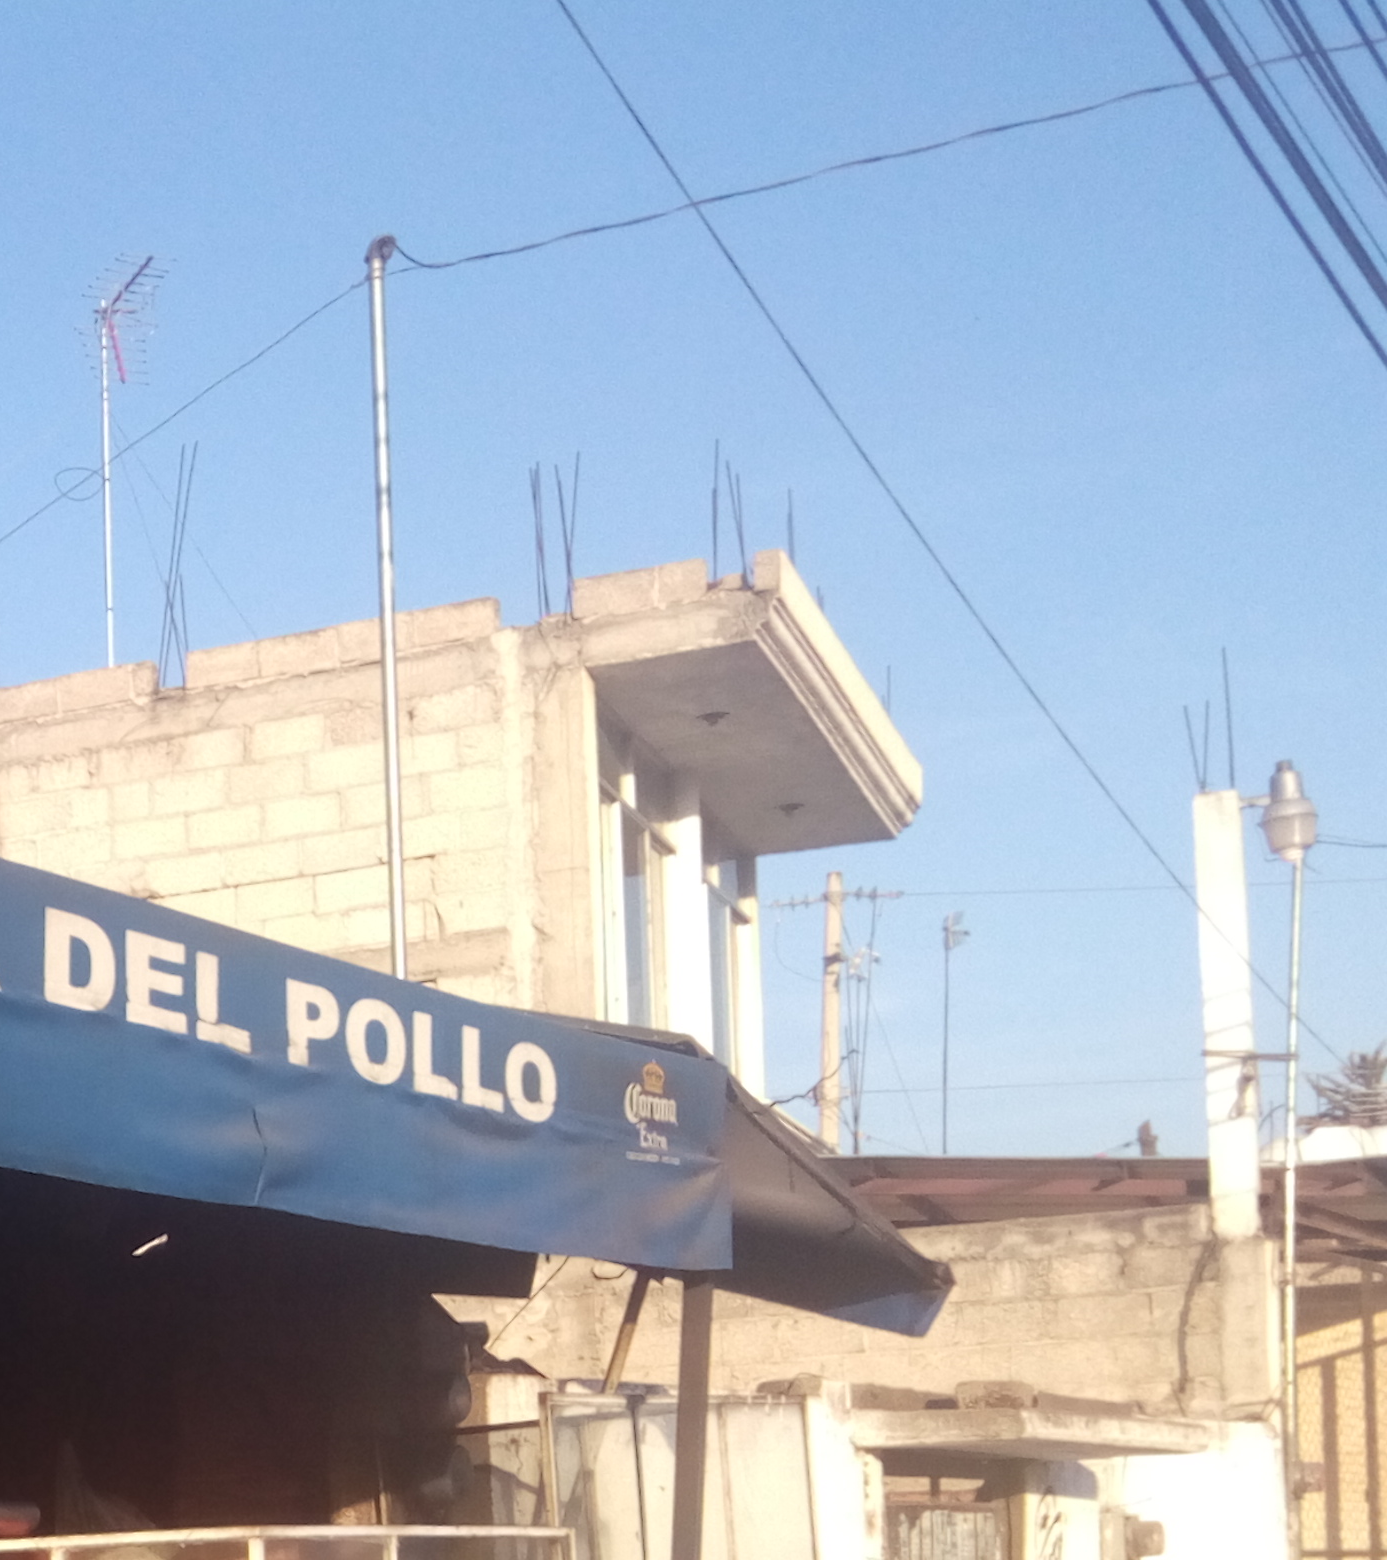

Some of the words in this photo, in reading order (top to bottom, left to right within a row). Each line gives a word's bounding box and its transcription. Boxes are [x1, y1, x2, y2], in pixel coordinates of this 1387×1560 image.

[43, 905, 252, 1054] DEL
[285, 977, 558, 1124] POLLO
[624, 1082, 678, 1126] Corona
[636, 1121, 668, 1151] Extra
